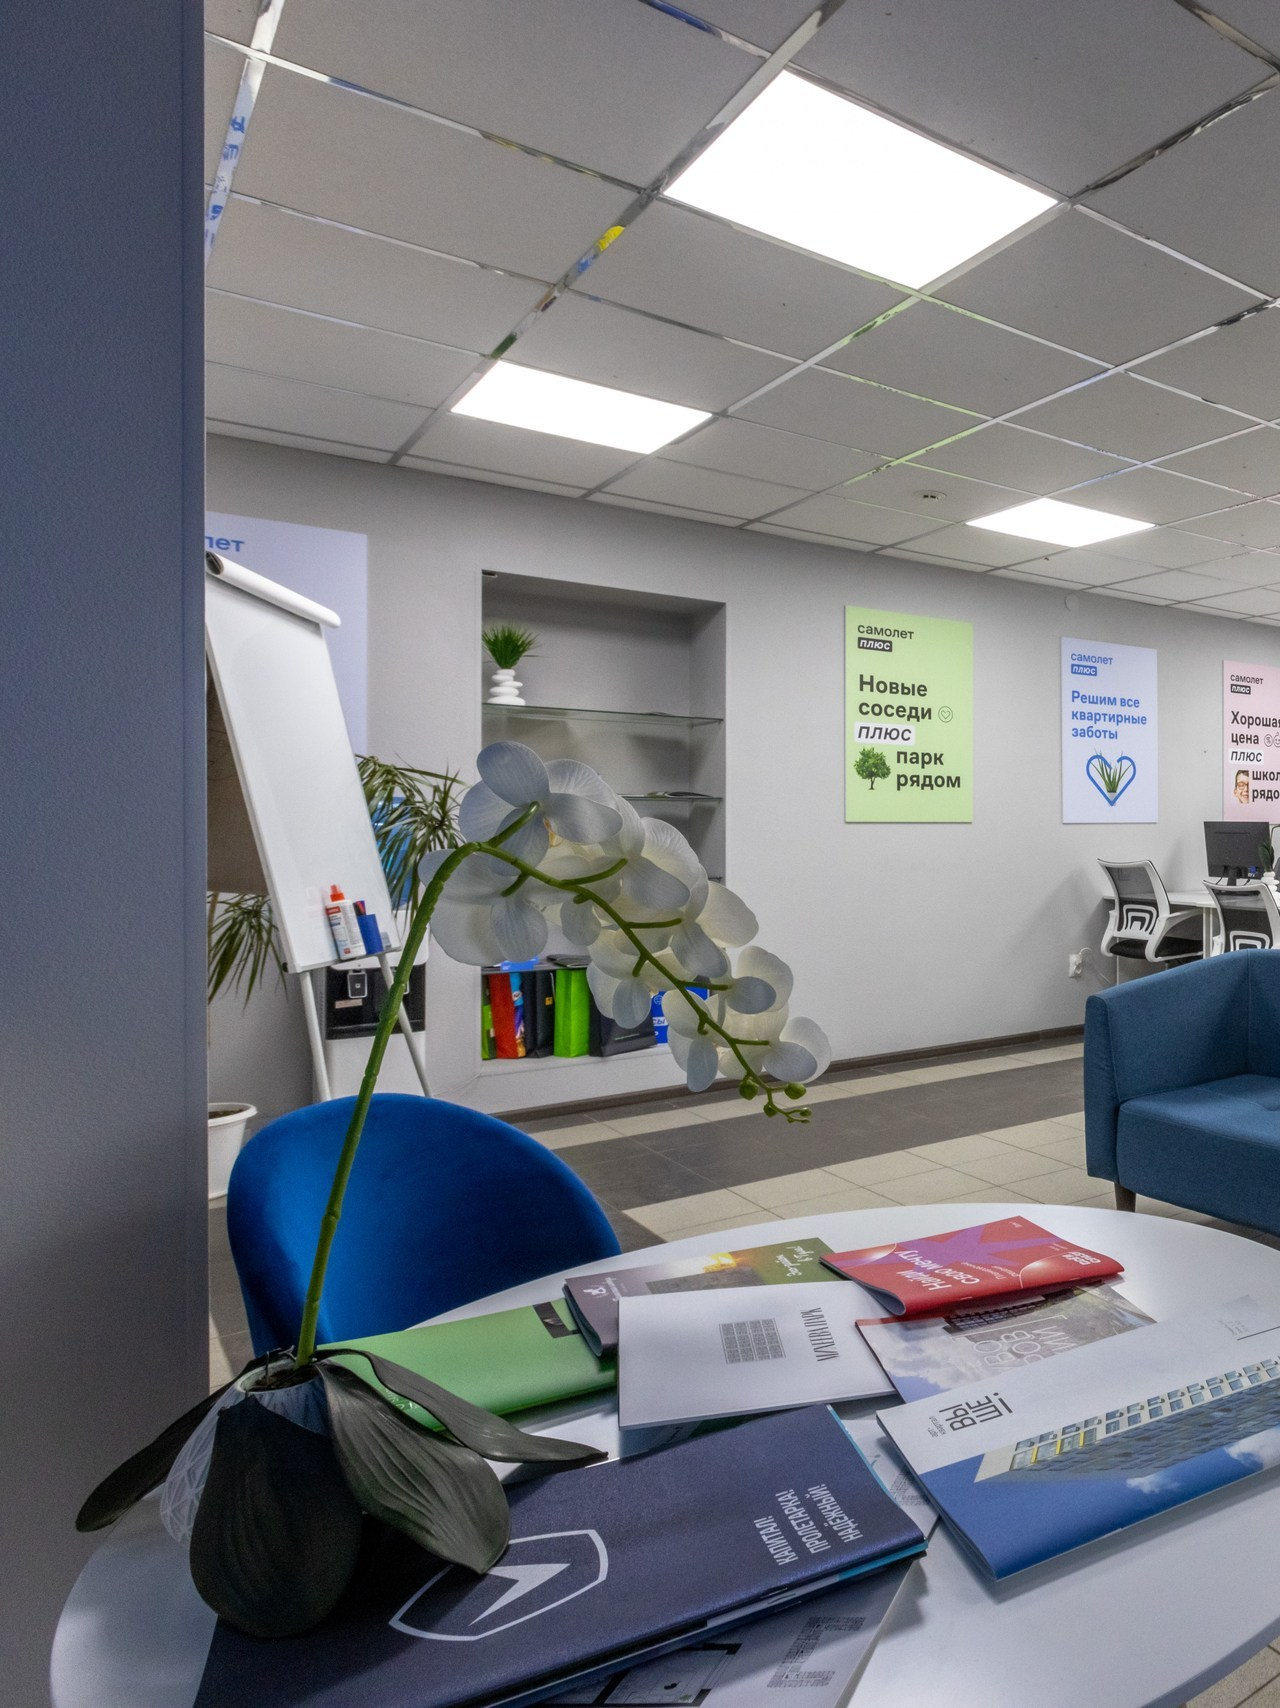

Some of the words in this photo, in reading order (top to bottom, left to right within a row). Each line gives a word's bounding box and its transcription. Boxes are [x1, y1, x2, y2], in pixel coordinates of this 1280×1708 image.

[857, 624, 914, 639] самолет
[859, 639, 891, 650] плюс
[1070, 653, 1113, 665] самолет
[1072, 665, 1096, 675] плюс
[859, 674, 928, 697] Новые
[1230, 674, 1264, 685] самолет
[1231, 685, 1250, 694] плюс
[1071, 690, 1117, 706] Решим
[1120, 697, 1140, 708] все
[858, 702, 932, 722] соседи
[1071, 710, 1147, 726] квартирные
[858, 726, 912, 741] плюс
[1071, 726, 1118, 740] заботы
[1231, 733, 1259, 745] цена
[897, 750, 944, 769] парк
[1230, 751, 1263, 762] плюс
[897, 773, 961, 791] рядом
[894, 1250, 943, 1271] мечту
[896, 1269, 952, 1291] Найди
[934, 1268, 980, 1285] свою
[939, 1403, 977, 1431] ВЫ
[965, 1395, 1003, 1423] ШЕ
[929, 1416, 947, 1435] квартал
[775, 1489, 832, 1554] ПРОЛЕТАРКА!
[804, 1483, 864, 1543] НАДЁЖНЫЙ!
[753, 1515, 799, 1566] КАПИТАЛ!
